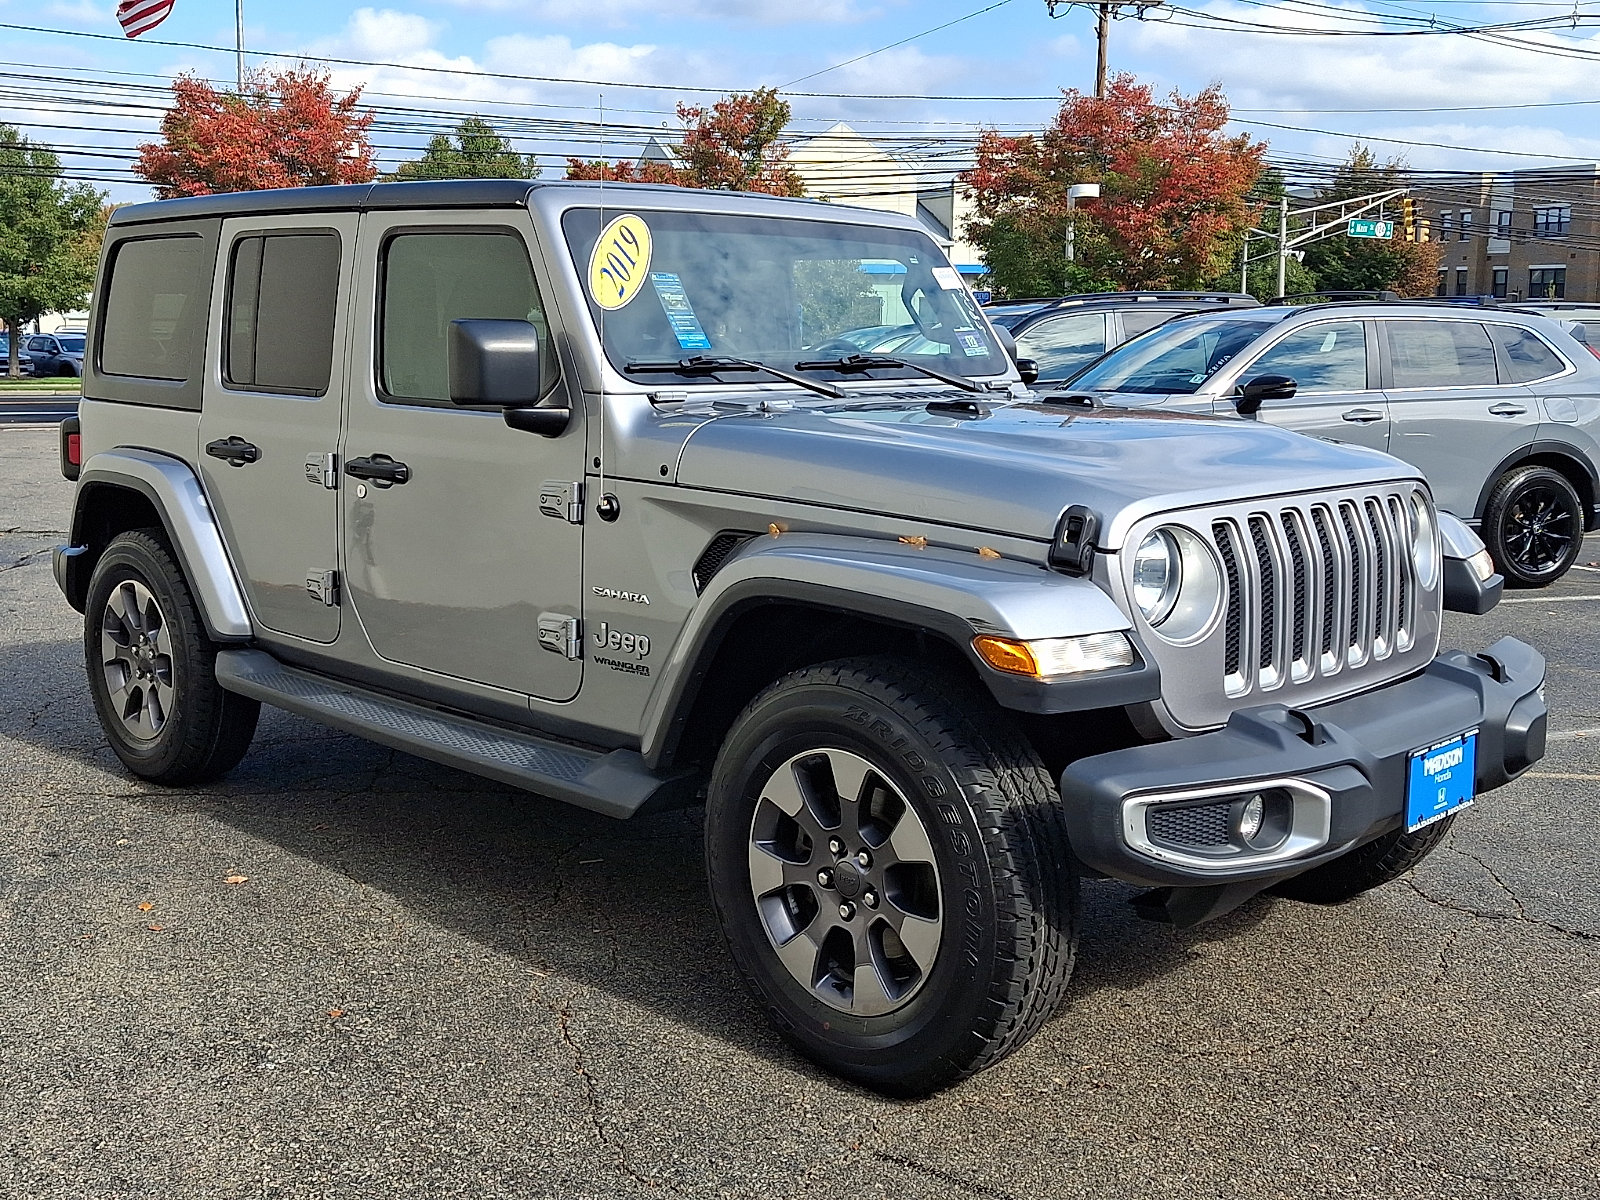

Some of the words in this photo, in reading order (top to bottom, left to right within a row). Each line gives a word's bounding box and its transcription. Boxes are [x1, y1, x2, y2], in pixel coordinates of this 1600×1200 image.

[600, 225, 639, 299] 2019
[591, 586, 650, 606] SAHARA
[592, 621, 651, 660] Jeep
[593, 655, 650, 673] WRANGLER
[1423, 746, 1464, 777] MADISON
[1434, 769, 1452, 784] Honda
[1407, 811, 1447, 834] MADISON
[1447, 799, 1475, 816] HONDA
